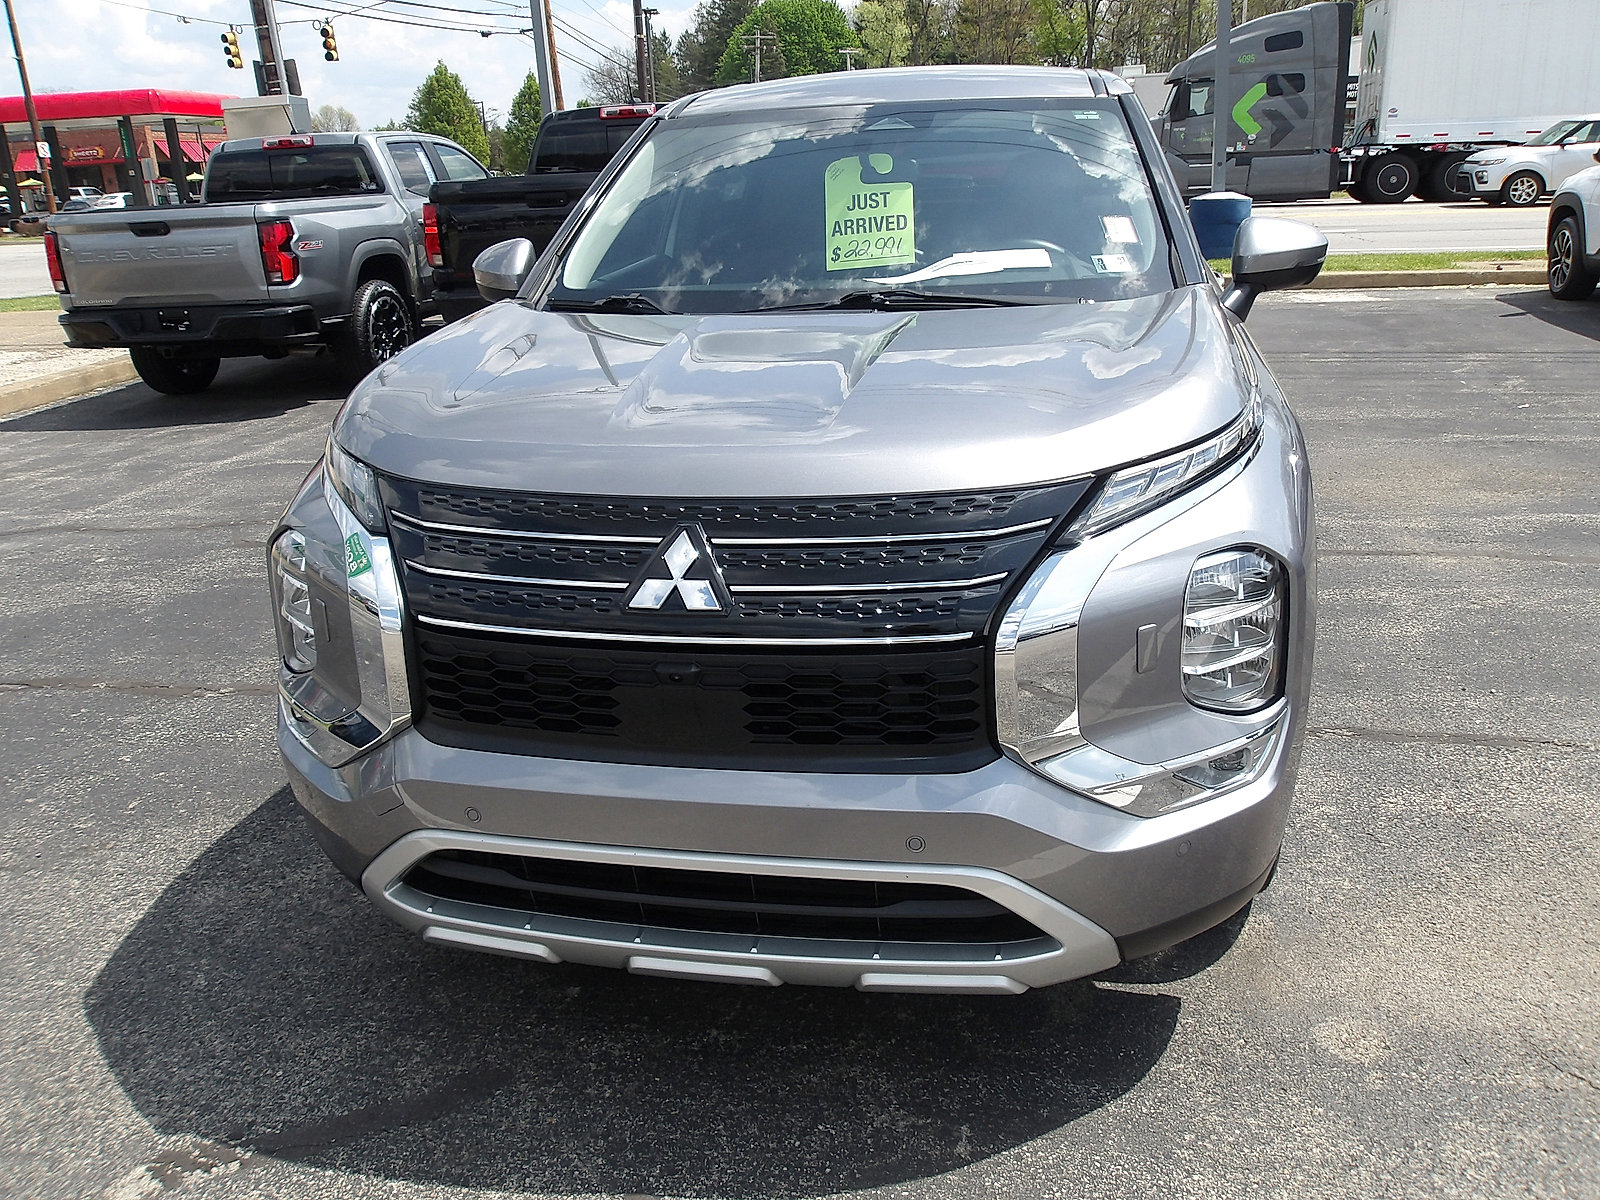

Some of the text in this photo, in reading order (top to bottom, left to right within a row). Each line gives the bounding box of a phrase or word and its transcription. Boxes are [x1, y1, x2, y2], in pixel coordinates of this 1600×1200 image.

[1237, 53, 1256, 64] 4095
[846, 191, 890, 212] JUST
[831, 214, 908, 238] ARRIVED
[78, 244, 234, 264] CHEVROLET
